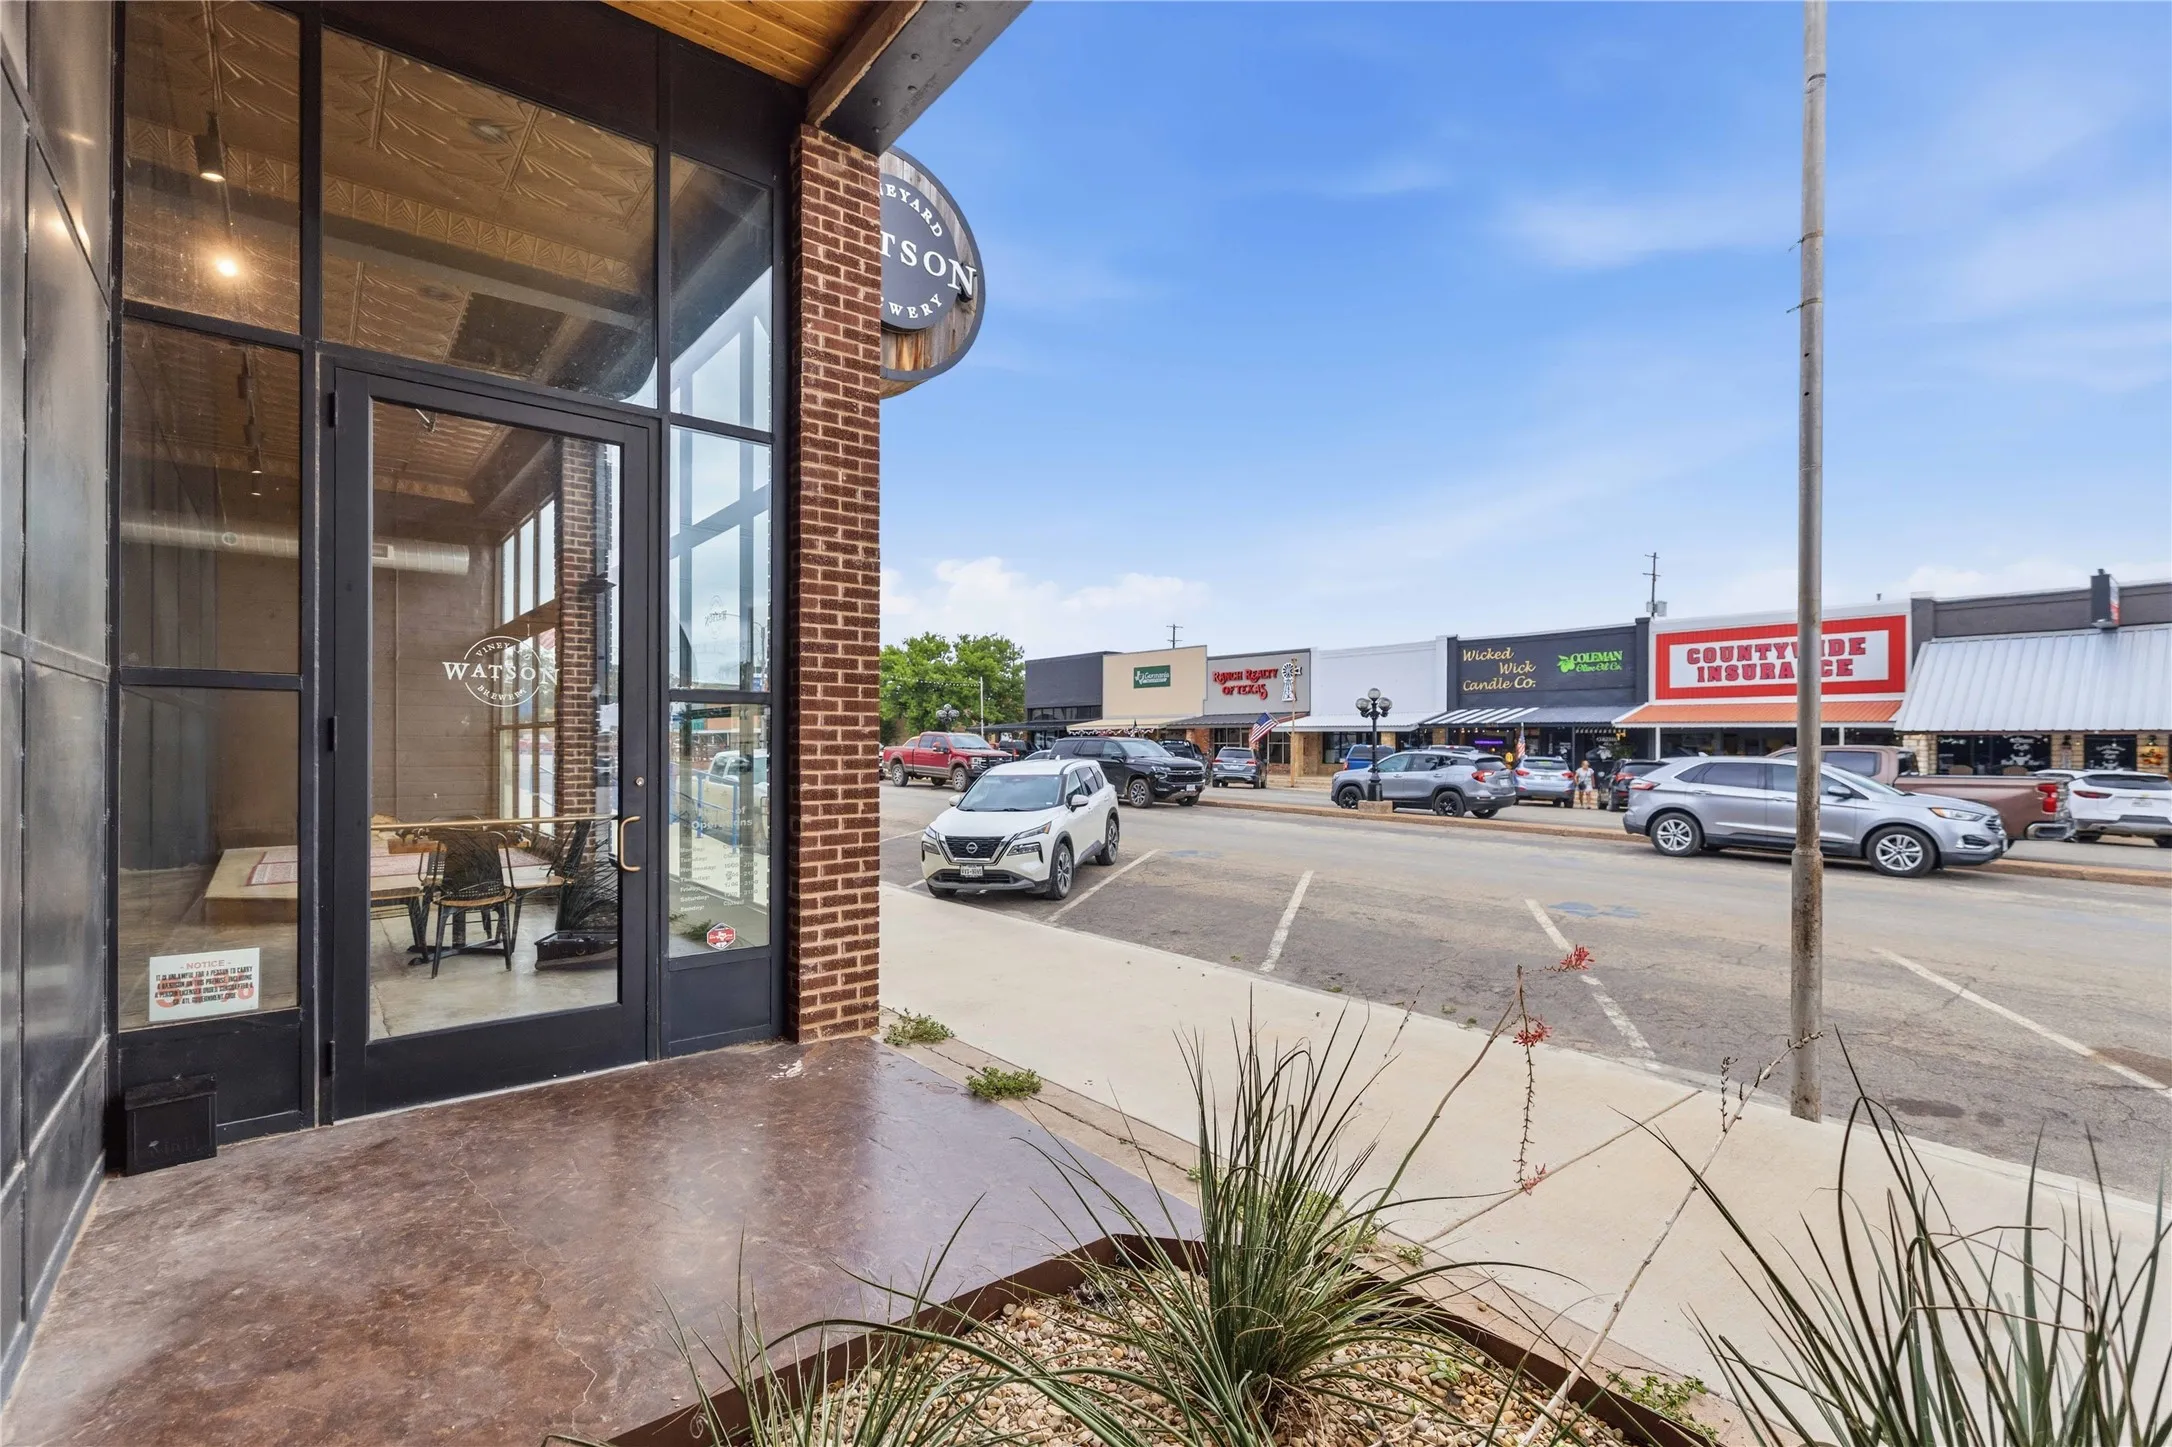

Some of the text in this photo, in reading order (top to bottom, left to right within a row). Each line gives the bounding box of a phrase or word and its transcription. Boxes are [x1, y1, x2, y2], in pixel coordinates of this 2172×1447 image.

[880, 183, 943, 237] EYARD
[1463, 647, 1515, 662] Wicked
[1570, 650, 1624, 664] COLEMAN
[1686, 636, 1867, 665] COUNTYDE
[442, 661, 560, 685] WATSON
[1499, 660, 1537, 675] Wick
[1697, 658, 1854, 683] INSURACE
[1212, 668, 1279, 685] RANCH REALTY
[1463, 675, 1537, 692] Candle Co.
[1222, 683, 1269, 700] OF TEXAS
[186, 959, 225, 970] NOTICE
